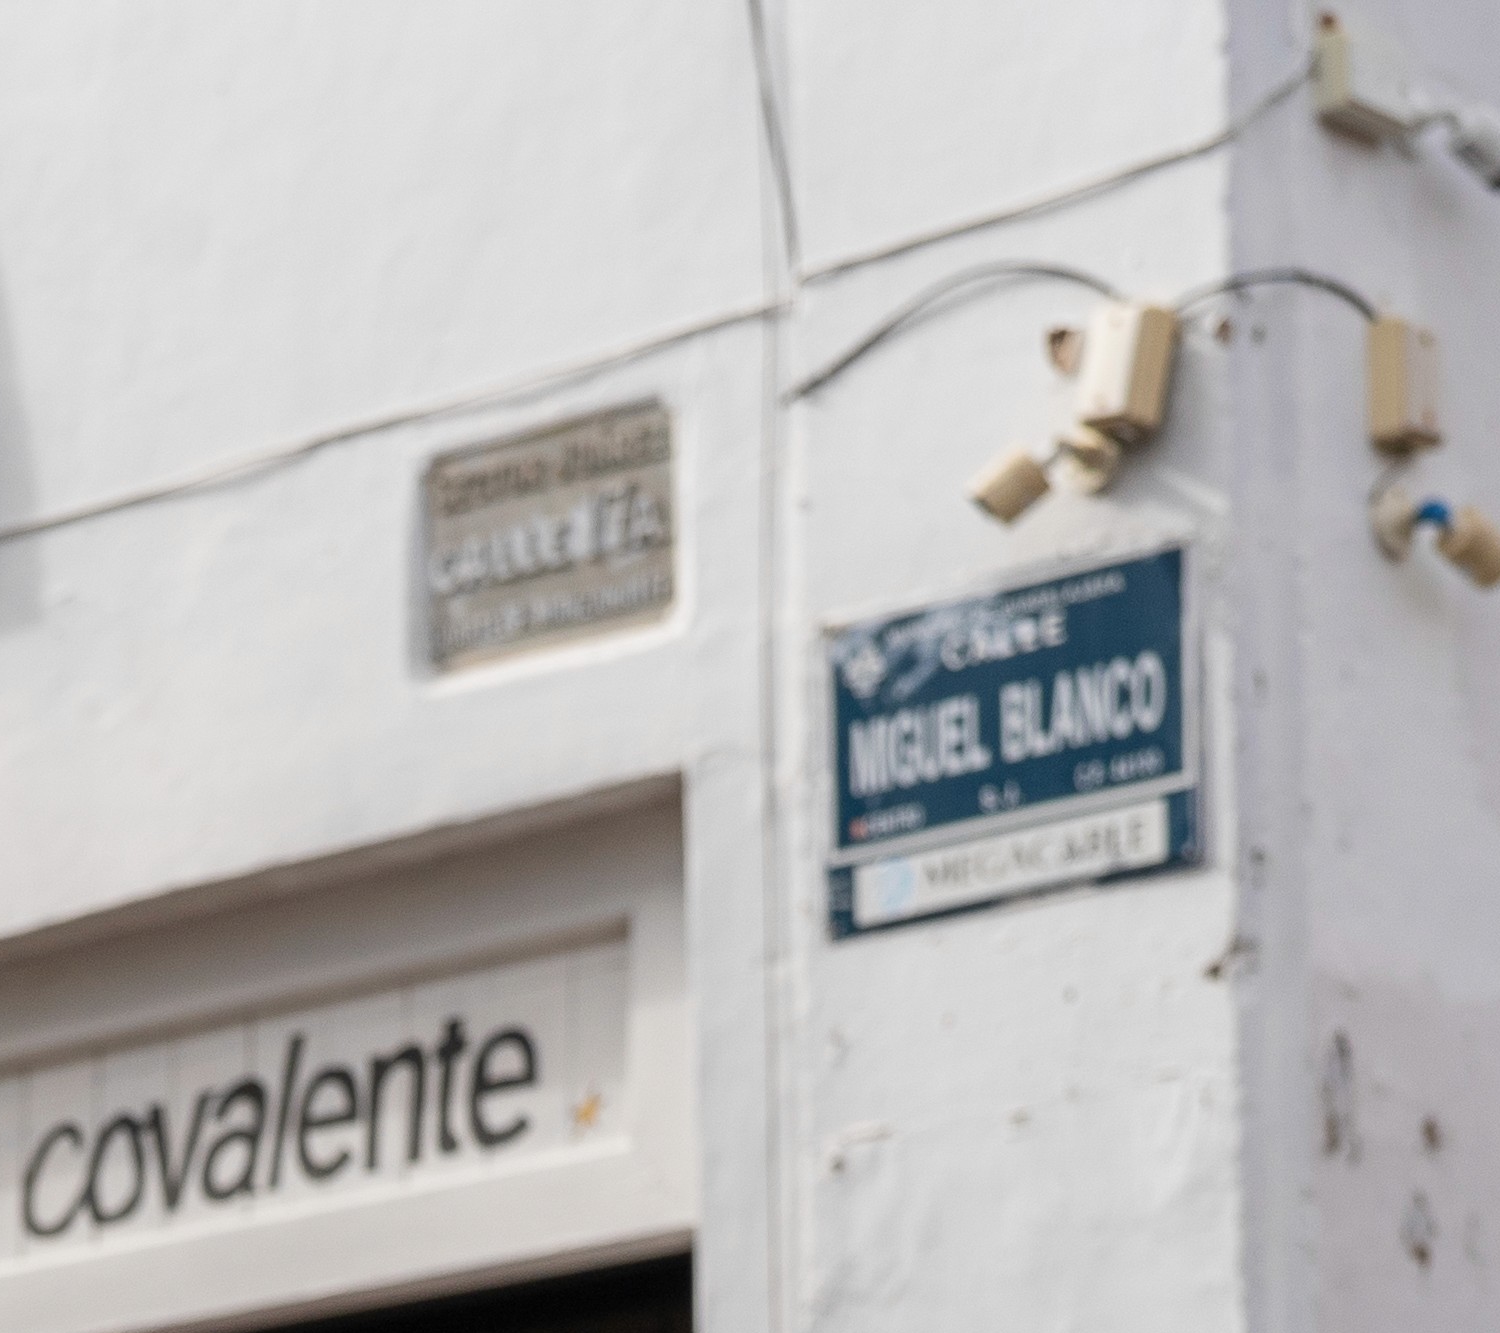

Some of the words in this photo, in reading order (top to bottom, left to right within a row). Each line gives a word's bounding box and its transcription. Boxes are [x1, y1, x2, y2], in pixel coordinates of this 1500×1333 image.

[848, 693, 993, 799] MIGUEL
[999, 648, 1168, 764] BLANCO
[20, 1014, 538, 1240] covalente
